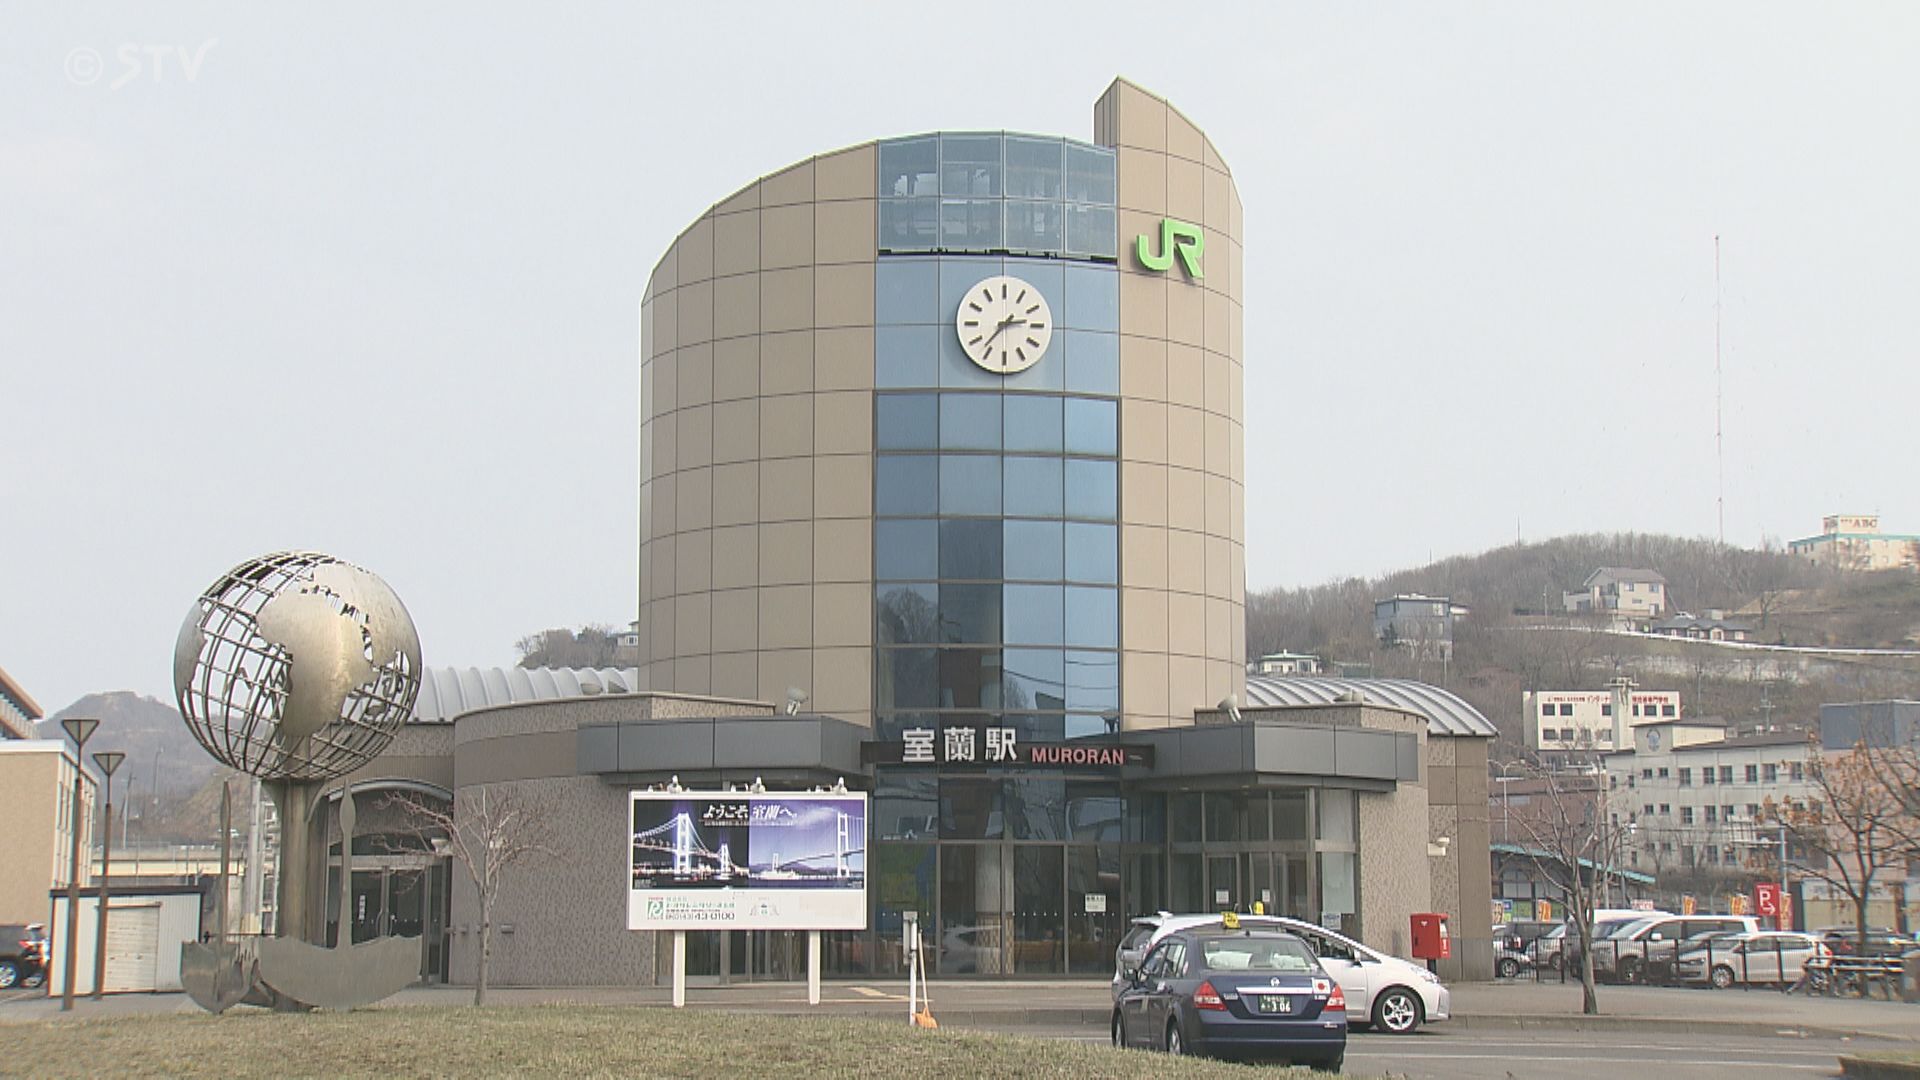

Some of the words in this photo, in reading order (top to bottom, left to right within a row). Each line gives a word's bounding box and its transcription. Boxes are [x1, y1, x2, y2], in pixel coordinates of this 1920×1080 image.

[1136, 218, 1204, 278] JR
[902, 727, 1017, 763] 室蘭駅
[1031, 748, 1125, 765] MURORAN
[1760, 889, 1771, 907] P
